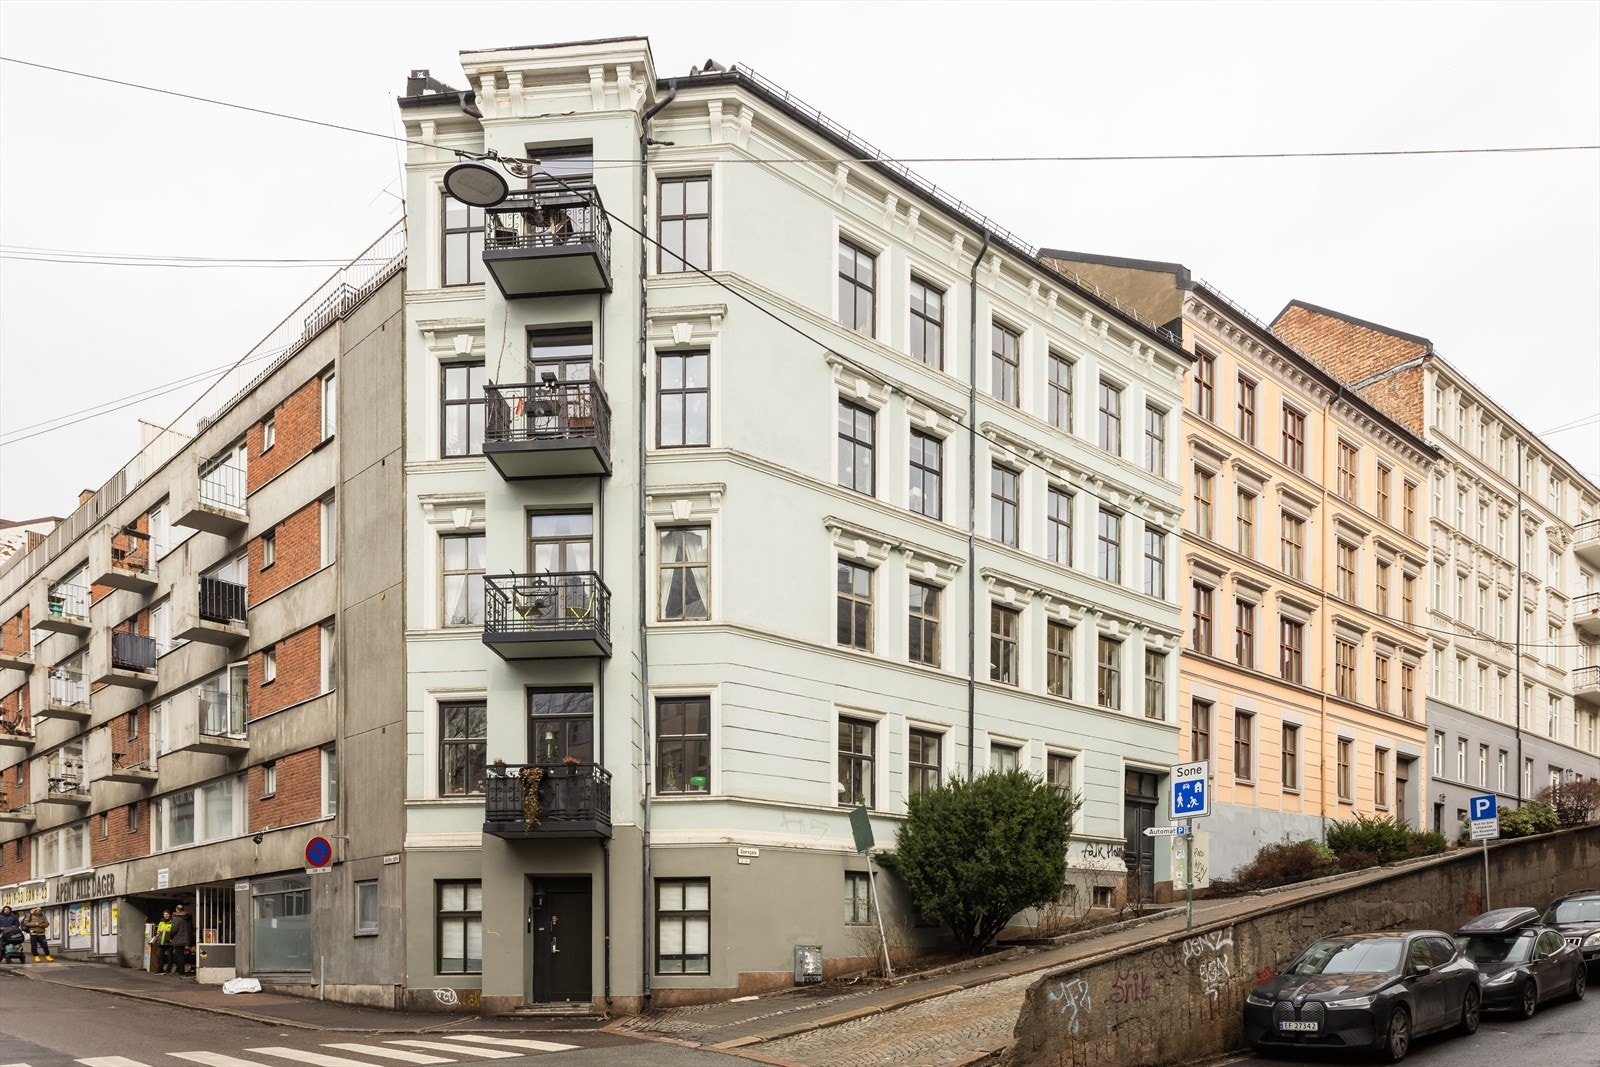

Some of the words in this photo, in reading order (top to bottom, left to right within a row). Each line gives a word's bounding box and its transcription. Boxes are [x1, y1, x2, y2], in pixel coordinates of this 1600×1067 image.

[1176, 766, 1203, 778] Sone
[1476, 799, 1490, 817] P
[1149, 828, 1176, 836] Automat
[77, 877, 91, 900] ALLE
[92, 873, 115, 897] DAGER
